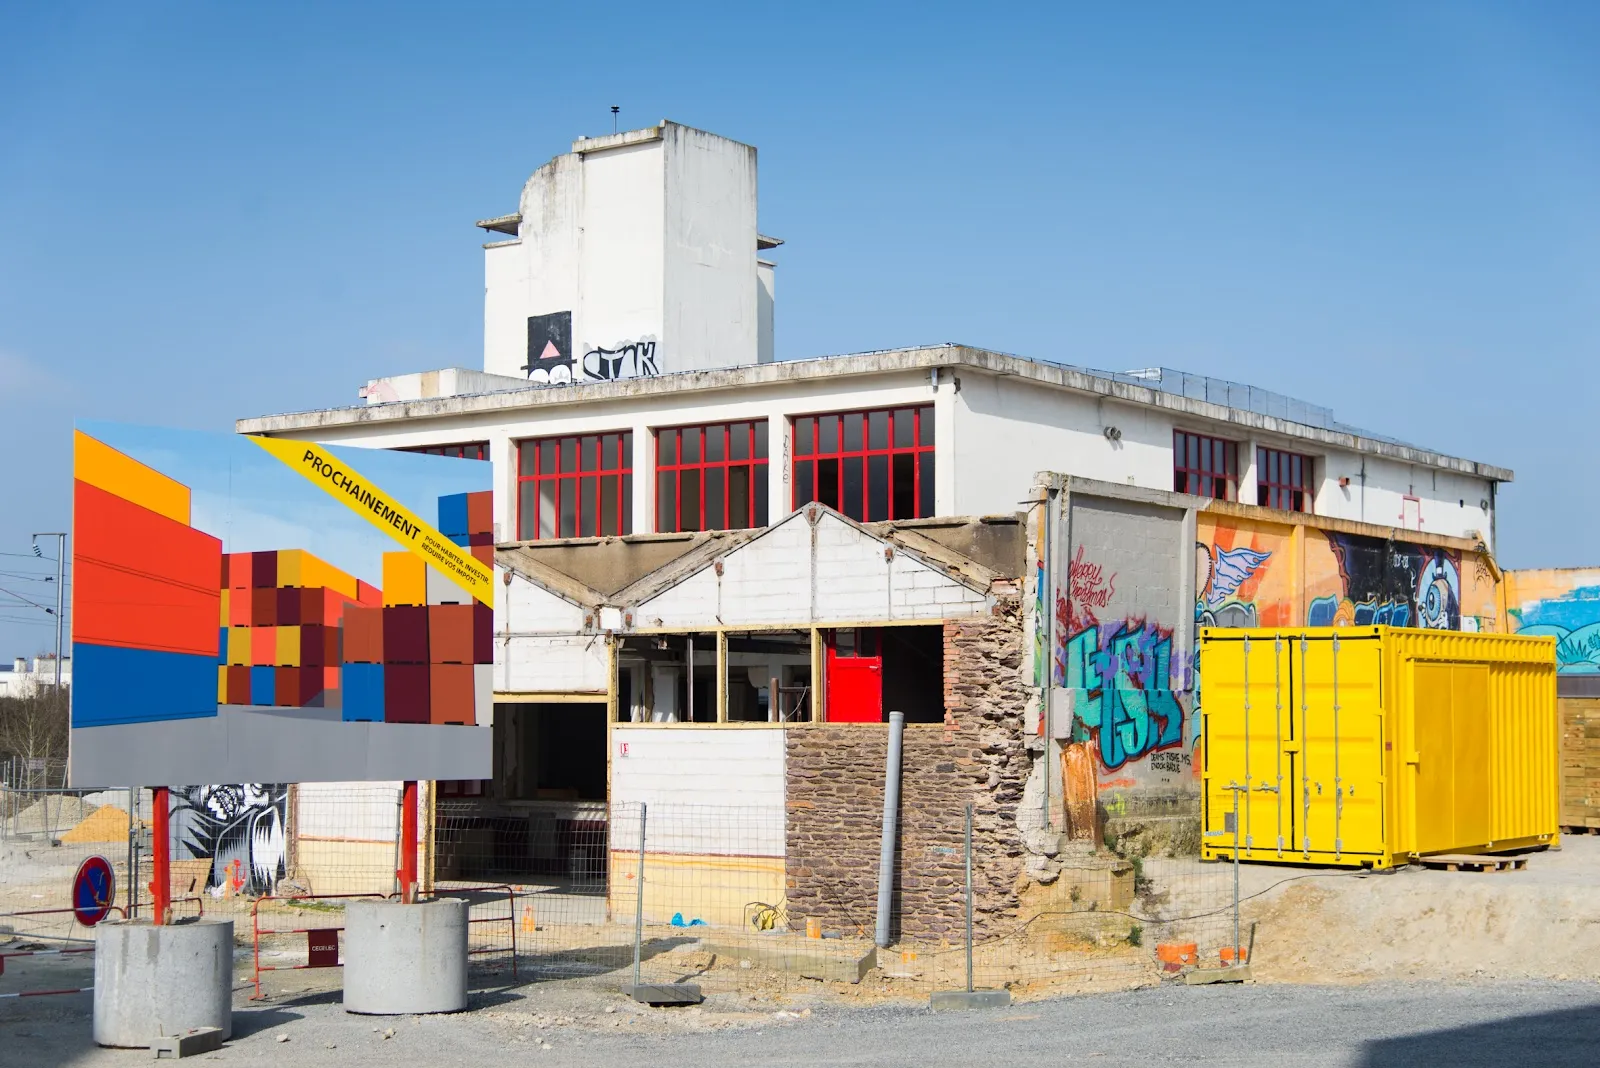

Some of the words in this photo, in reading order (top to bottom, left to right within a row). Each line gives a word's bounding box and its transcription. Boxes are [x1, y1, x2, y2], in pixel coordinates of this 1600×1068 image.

[302, 449, 421, 540] PROCHAINEMENT
[425, 535, 441, 550] POUR
[440, 546, 464, 568] HABITER,
[464, 563, 490, 585] INVESTIR,
[444, 558, 456, 571] VOS
